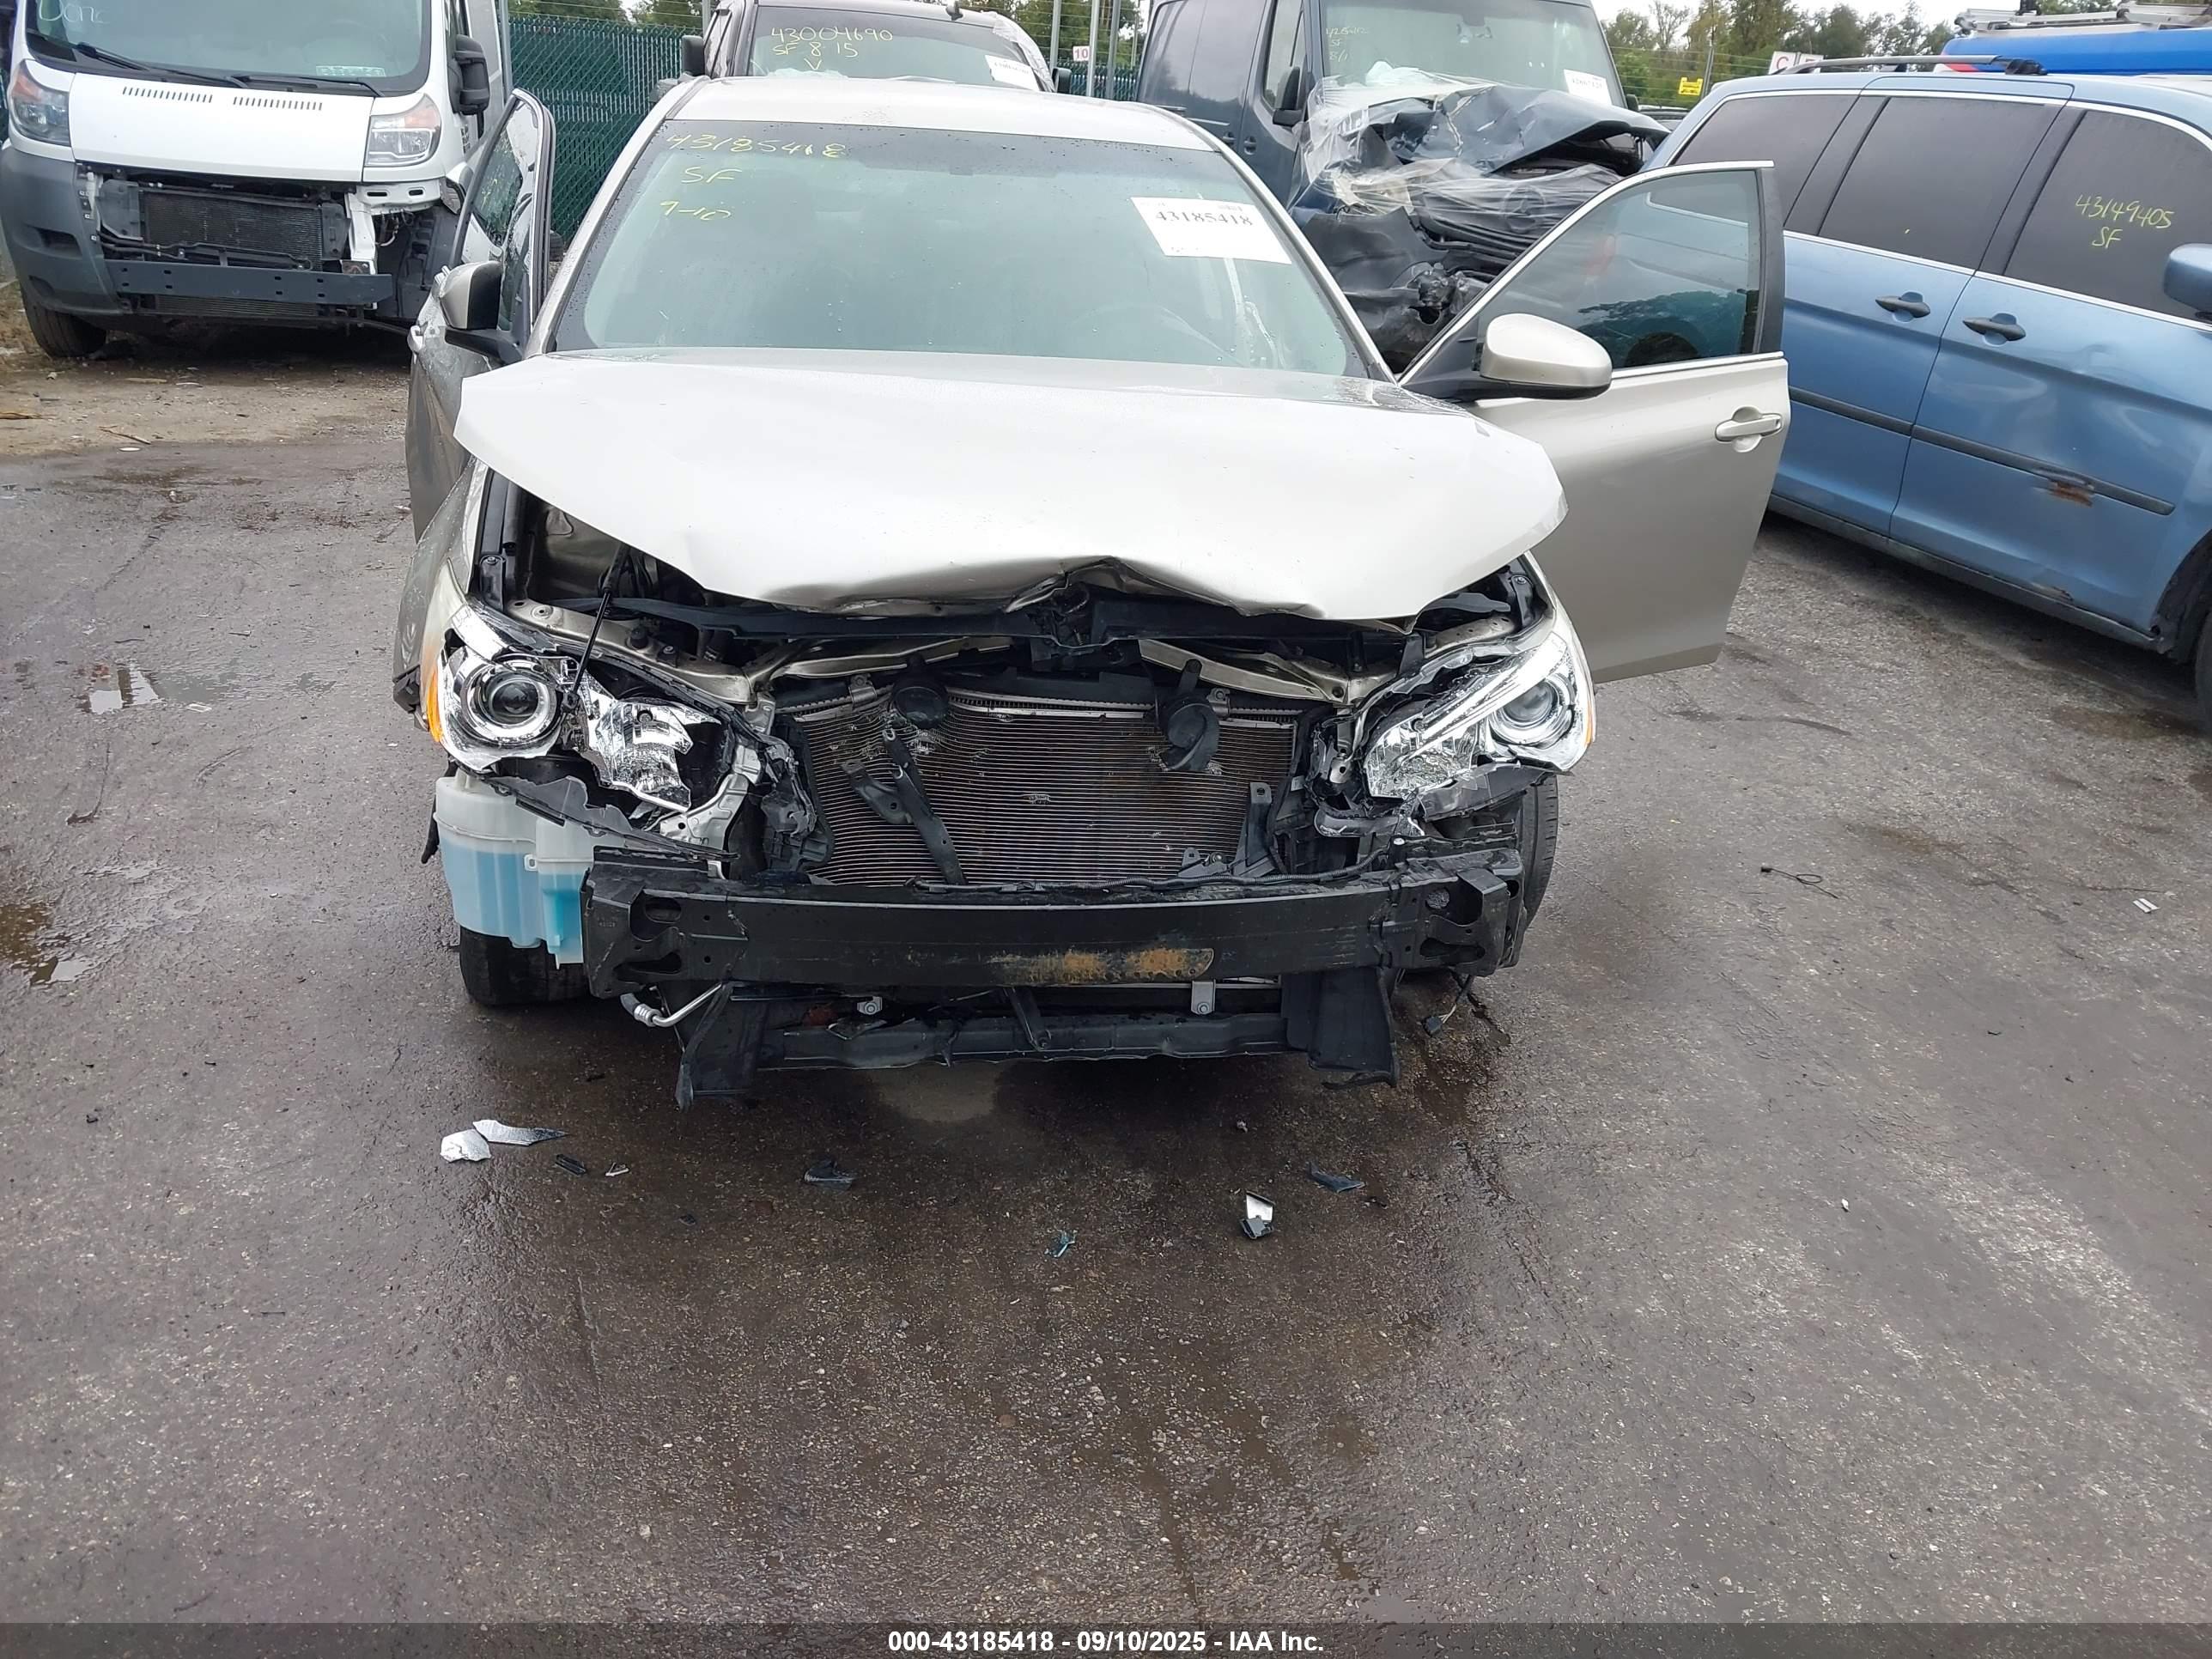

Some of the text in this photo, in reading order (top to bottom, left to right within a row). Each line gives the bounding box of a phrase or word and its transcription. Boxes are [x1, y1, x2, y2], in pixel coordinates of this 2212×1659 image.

[771, 27, 893, 43] 43004690
[772, 41, 859, 58] SF 8 15
[1074, 50, 1089, 59] 10
[681, 167, 743, 184] SF
[1156, 210, 1254, 227] 43185418
[2075, 194, 2175, 228] 43149405
[2092, 226, 2124, 249] SF
